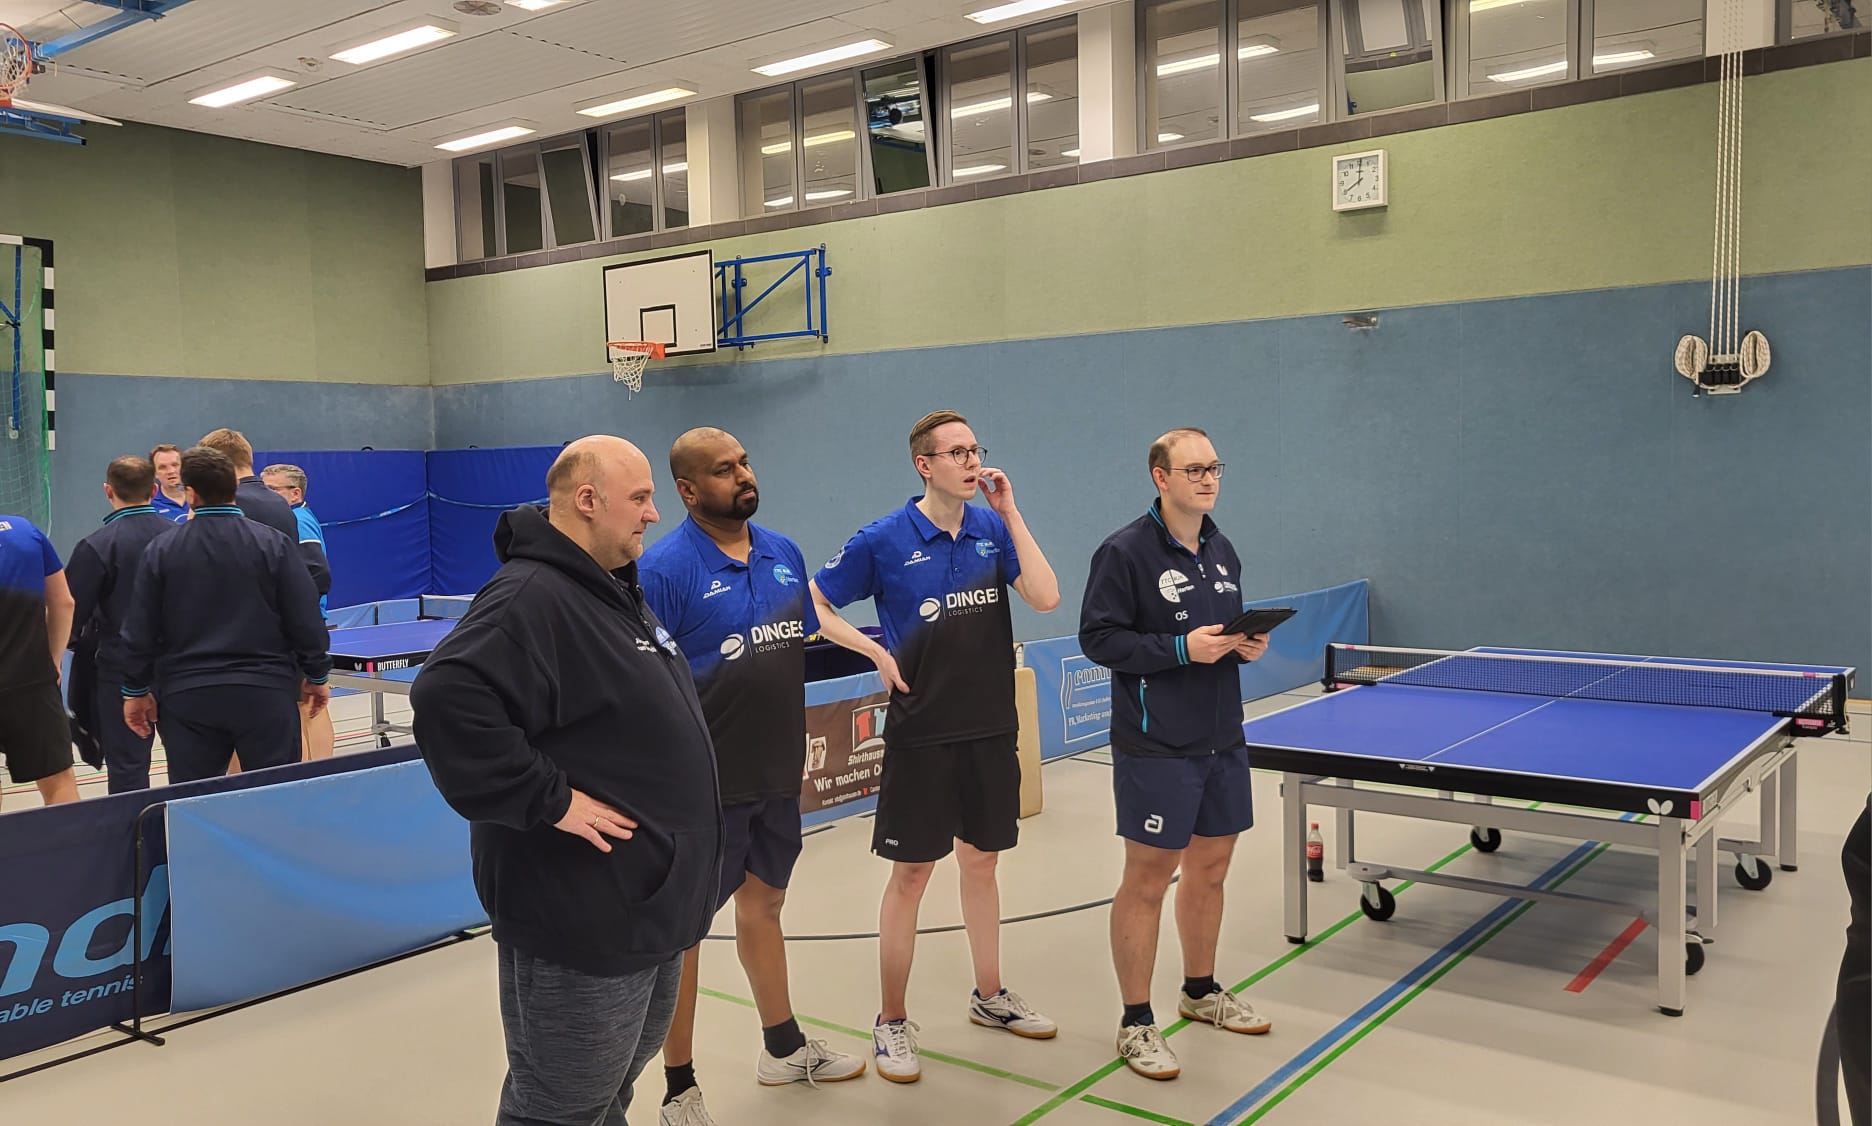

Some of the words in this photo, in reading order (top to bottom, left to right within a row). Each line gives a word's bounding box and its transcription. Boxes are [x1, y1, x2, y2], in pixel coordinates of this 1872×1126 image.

[949, 607, 983, 617] LOGISTICS
[1175, 610, 1189, 621] OS
[755, 641, 790, 653] LOGISTICS
[378, 659, 409, 671] BUTTERFLY
[814, 777, 832, 792] Wir
[835, 768, 870, 787] machen
